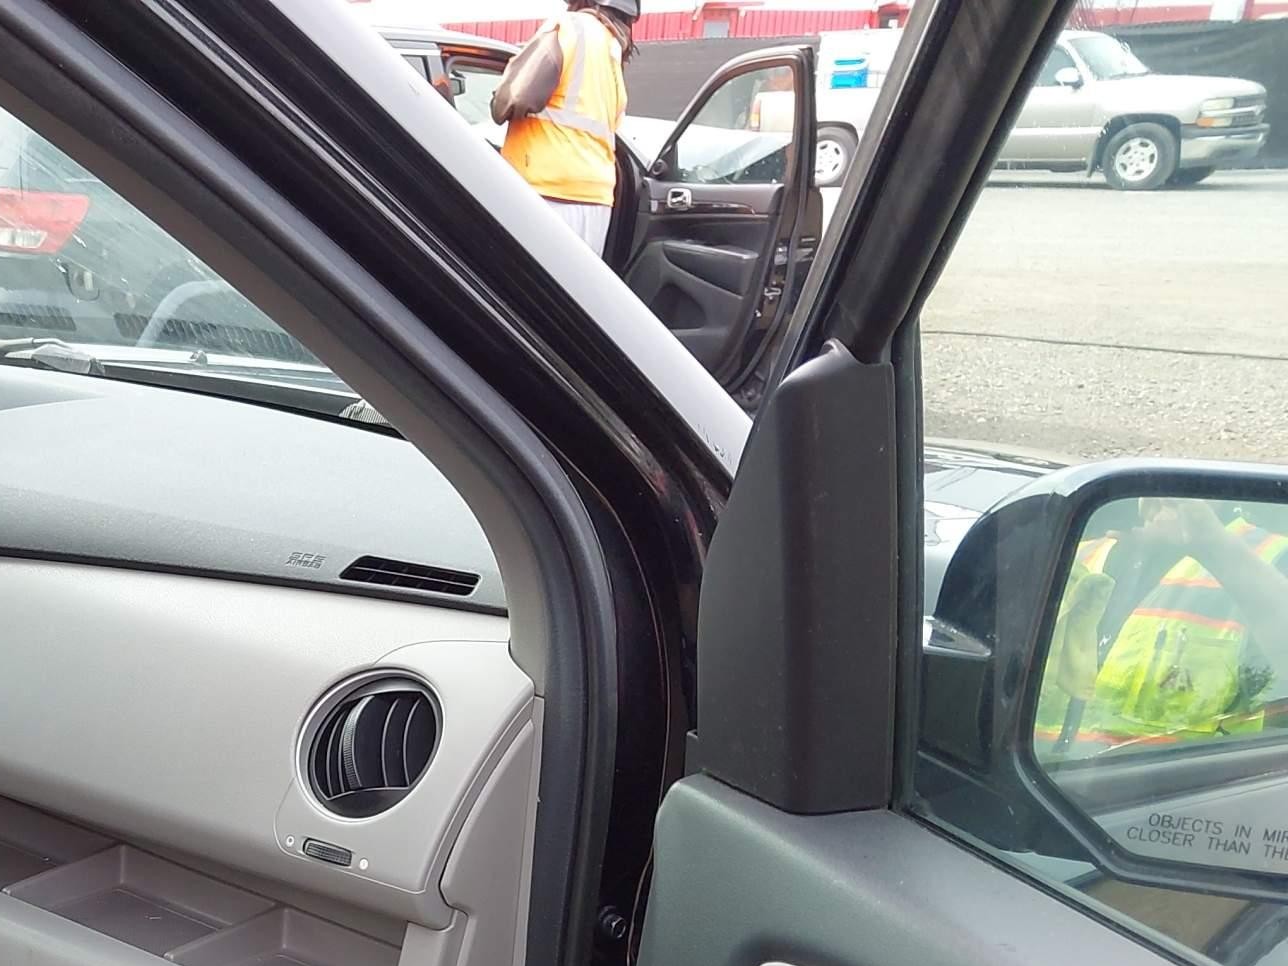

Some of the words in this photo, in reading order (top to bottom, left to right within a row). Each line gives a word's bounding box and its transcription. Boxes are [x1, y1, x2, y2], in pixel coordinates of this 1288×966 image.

[1148, 813, 1224, 834] OBJECTS
[1234, 824, 1252, 839] IN
[1126, 826, 1195, 847] CLOSER
[1207, 837, 1252, 855] THAN
